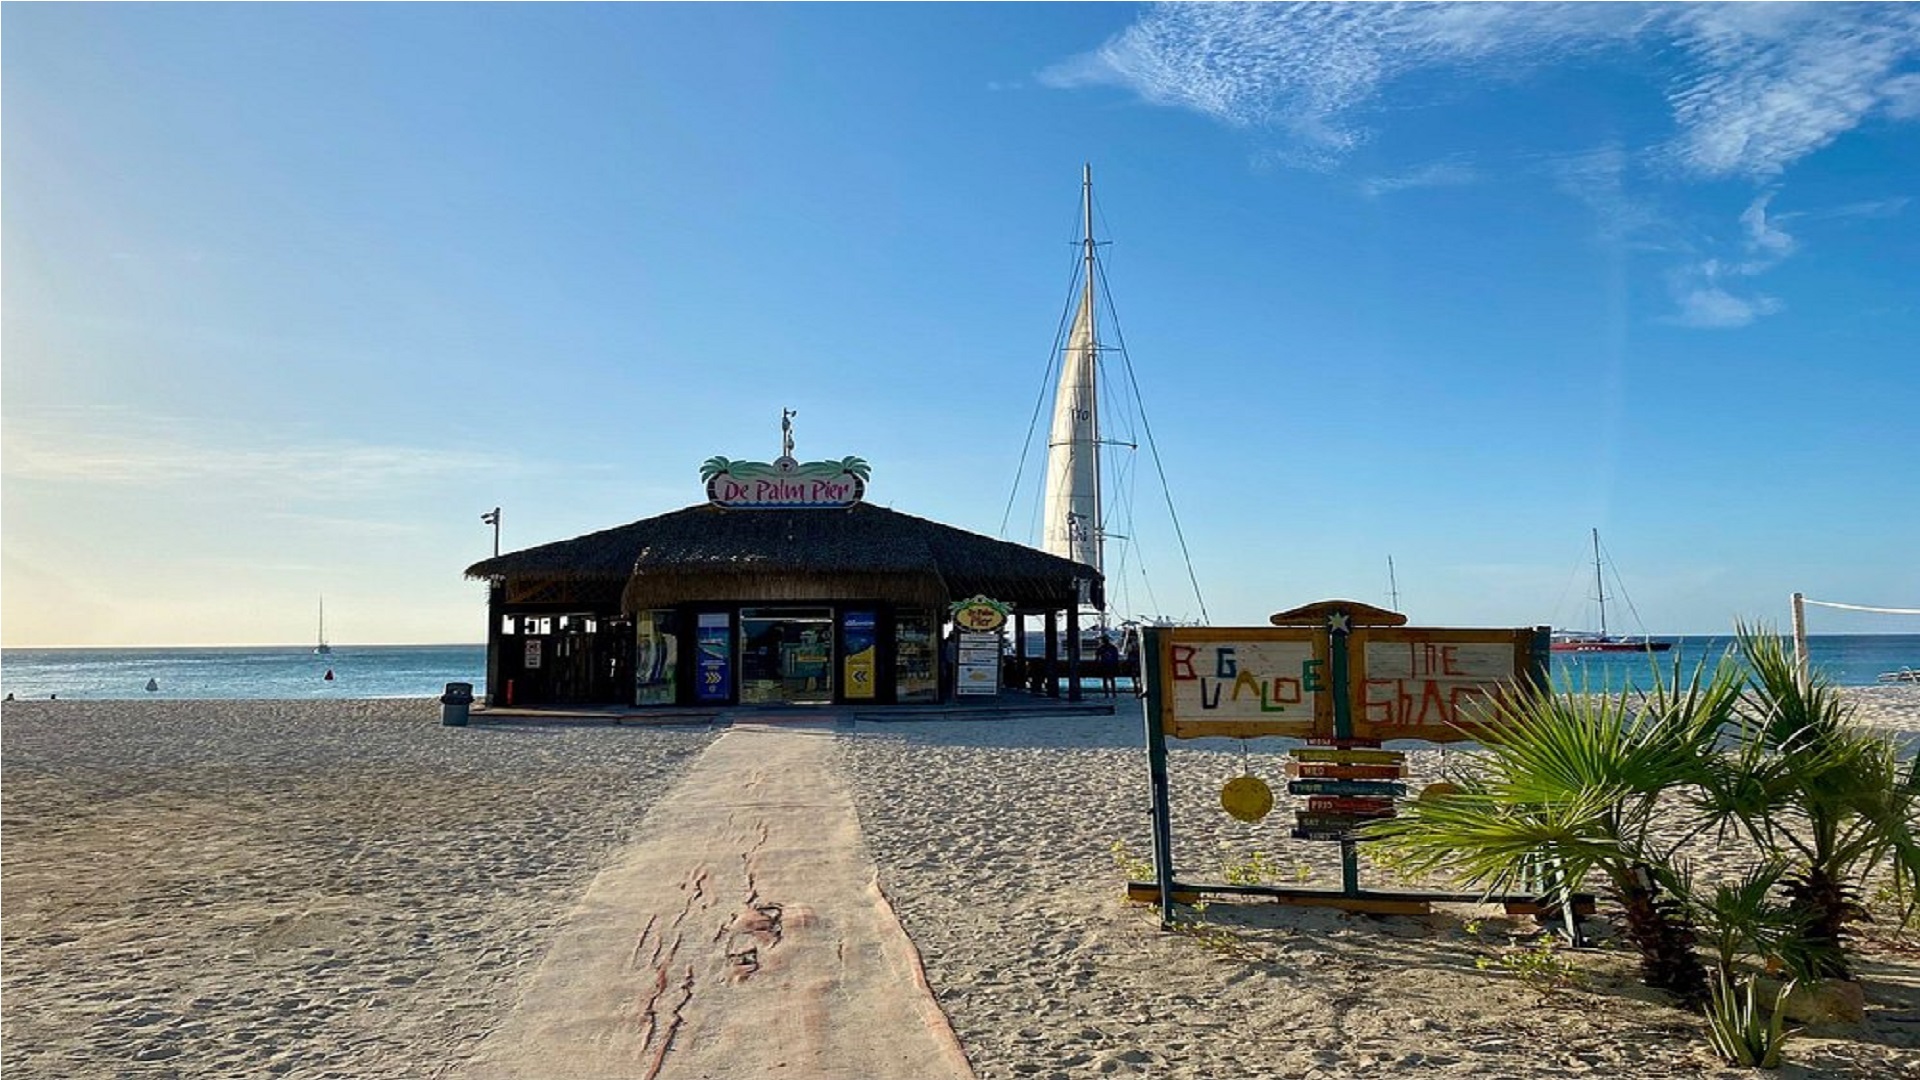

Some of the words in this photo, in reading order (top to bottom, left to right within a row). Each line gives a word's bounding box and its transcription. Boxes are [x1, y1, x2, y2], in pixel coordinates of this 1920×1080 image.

[724, 480, 749, 501] De
[756, 479, 804, 502] Palm
[811, 479, 850, 502] Pier
